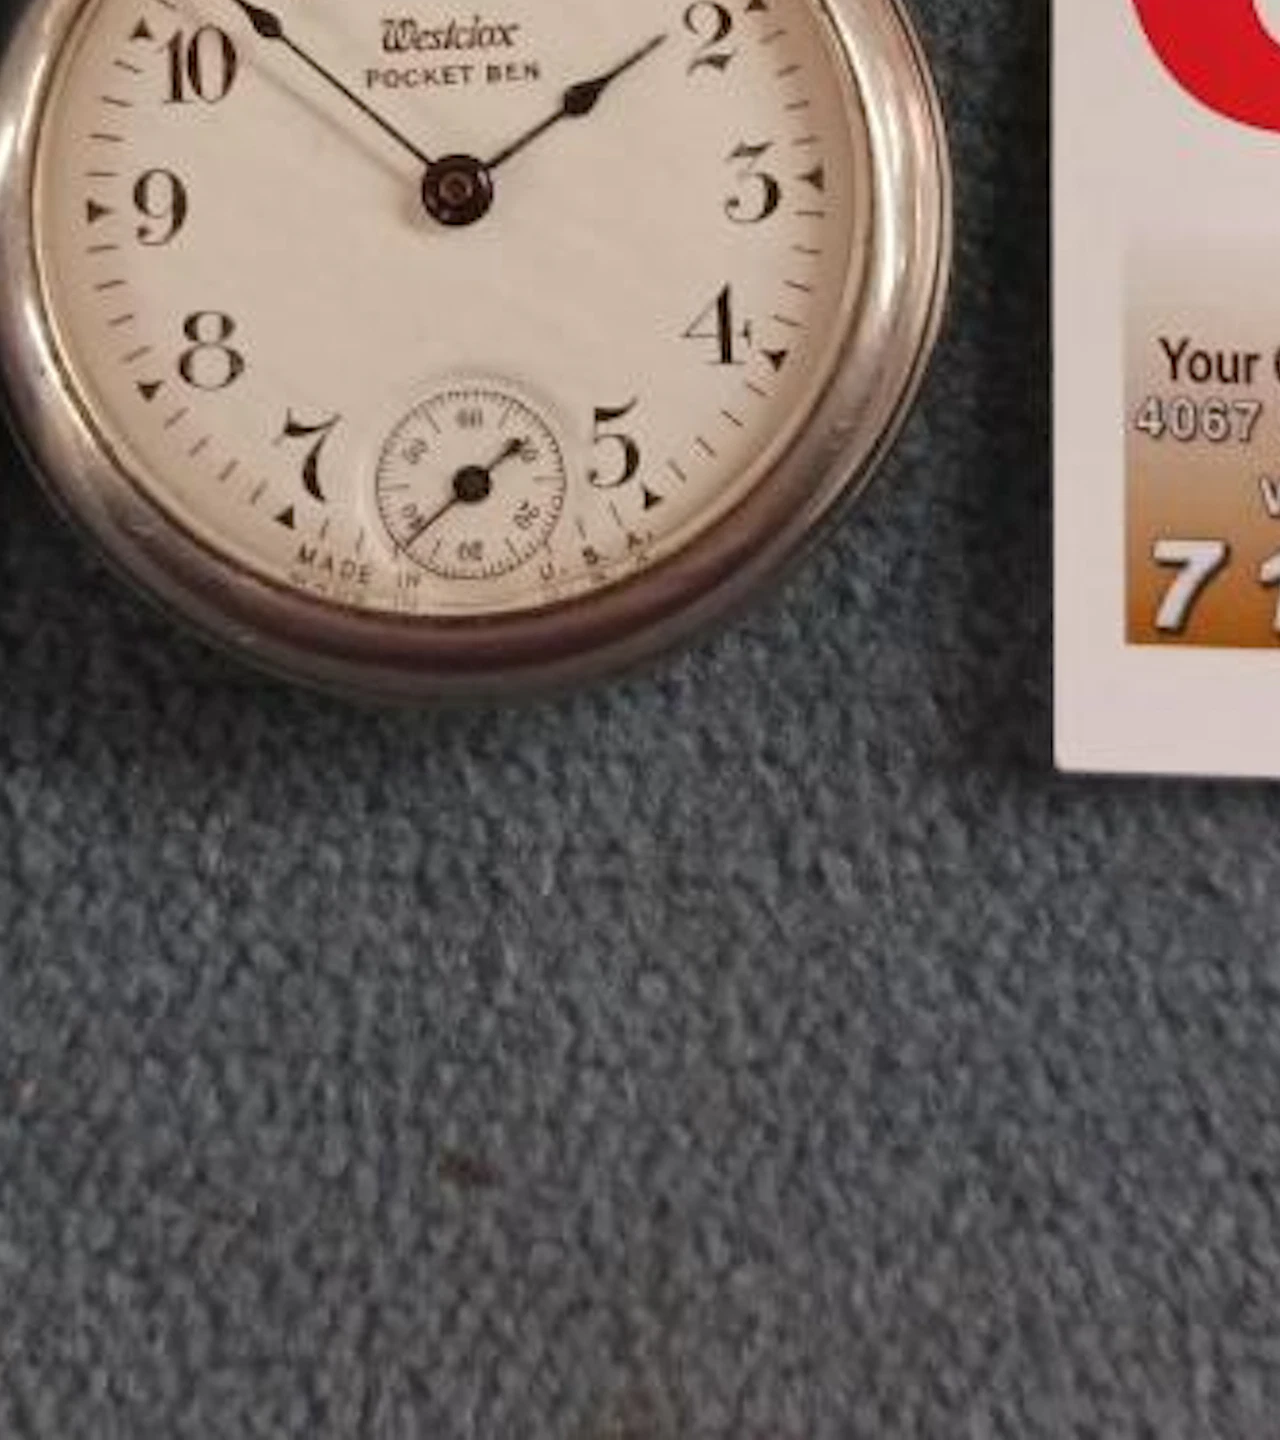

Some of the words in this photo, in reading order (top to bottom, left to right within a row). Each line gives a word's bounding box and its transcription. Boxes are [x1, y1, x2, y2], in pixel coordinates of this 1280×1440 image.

[162, 23, 237, 104] 10
[381, 15, 520, 53] Westclox
[683, 0, 735, 76] 2
[364, 66, 475, 89] POCKET
[486, 62, 541, 83] BEN
[132, 168, 187, 246] 9
[724, 142, 781, 224] 3
[179, 310, 245, 390] 8
[680, 282, 752, 365] 4
[1159, 338, 1260, 385] Your
[275, 408, 343, 502] 7
[588, 397, 640, 488] 5
[1135, 396, 1263, 442] 4067
[298, 544, 370, 584] MADE
